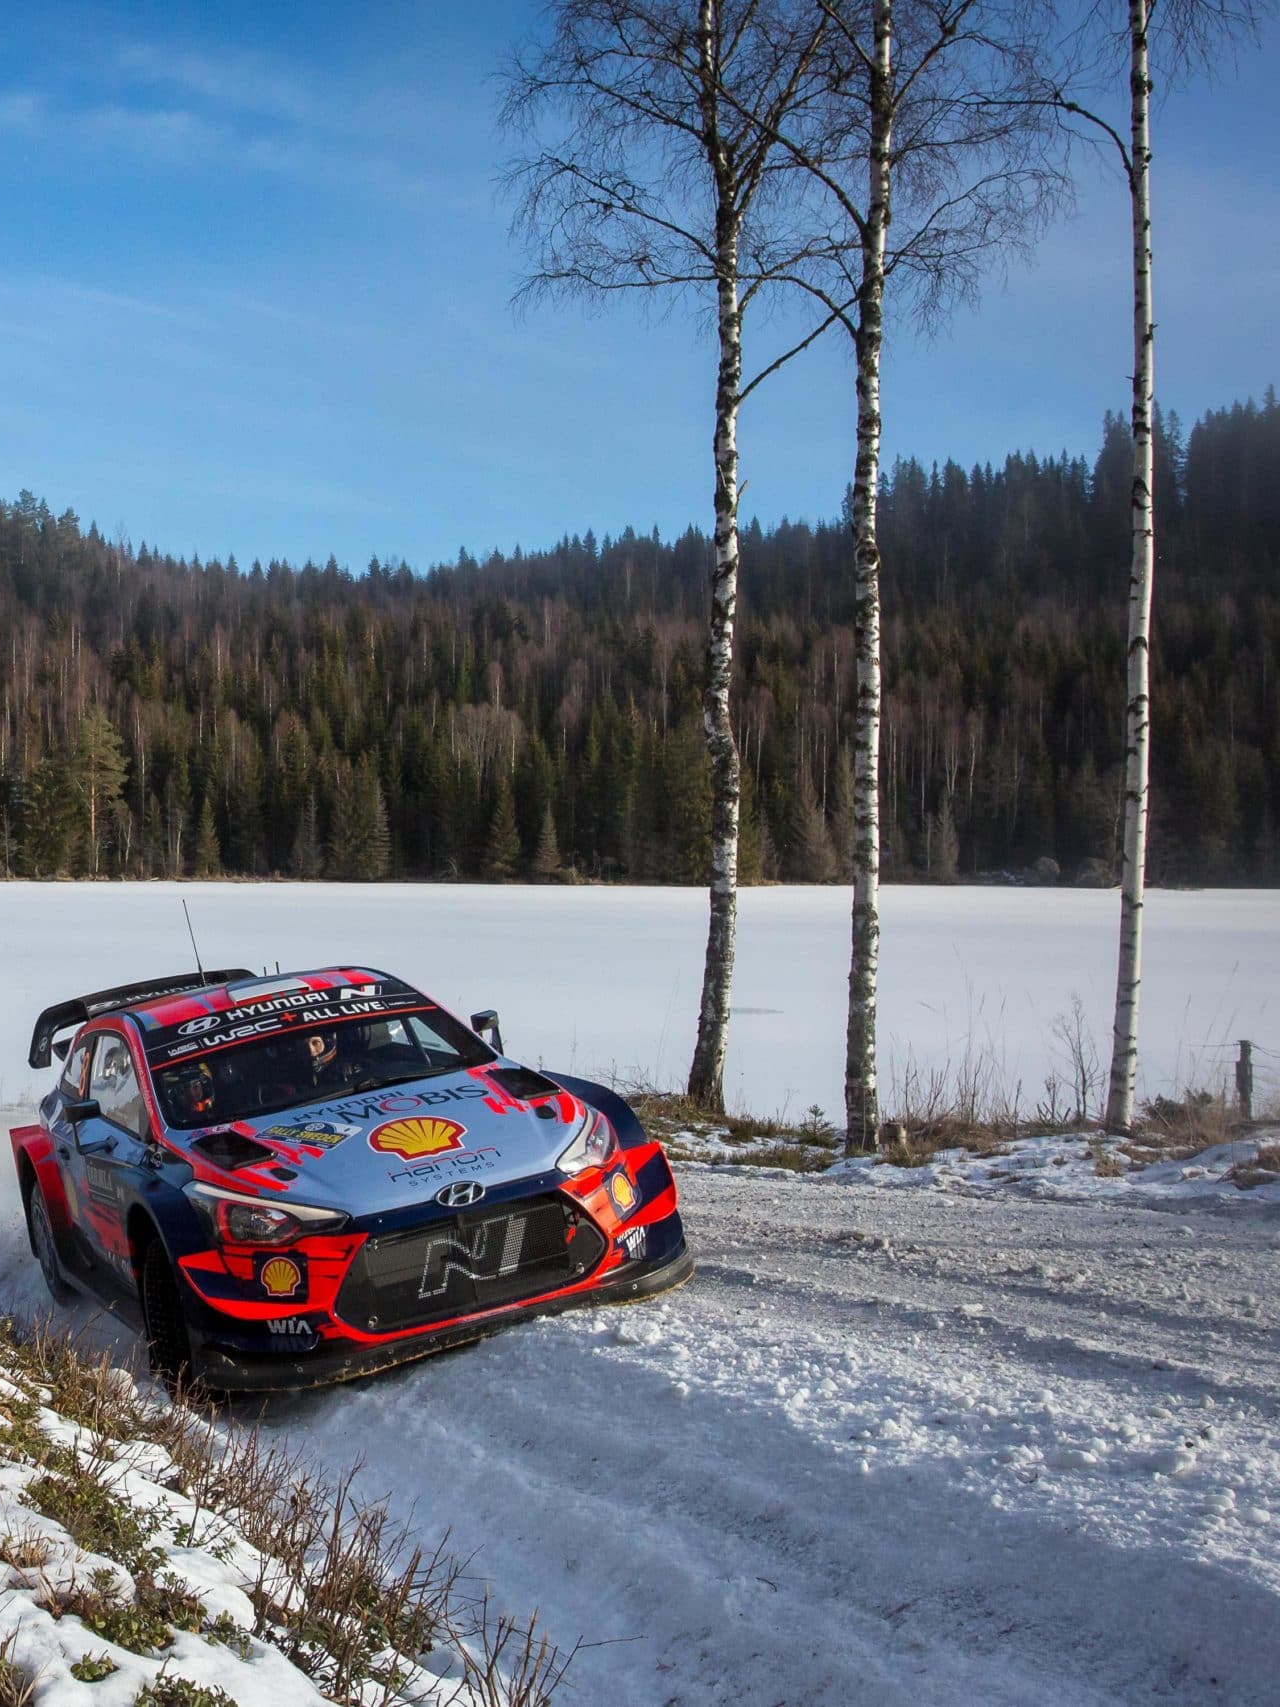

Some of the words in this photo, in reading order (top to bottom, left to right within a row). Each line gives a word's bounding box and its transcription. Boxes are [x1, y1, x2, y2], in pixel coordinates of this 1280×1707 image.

[226, 992, 329, 1021] HYUNDAI
[302, 1008, 339, 1023] ALL
[341, 1000, 385, 1017] LIVE
[293, 1091, 405, 1122] HYUNDAI
[338, 1084, 490, 1124] MOBIS
[269, 1125, 300, 1136] RALLY
[295, 1130, 344, 1144] SWEDEN
[408, 1161, 496, 1187] SYSTEMS
[626, 1225, 646, 1252] WIA
[266, 1316, 313, 1335] WIA
